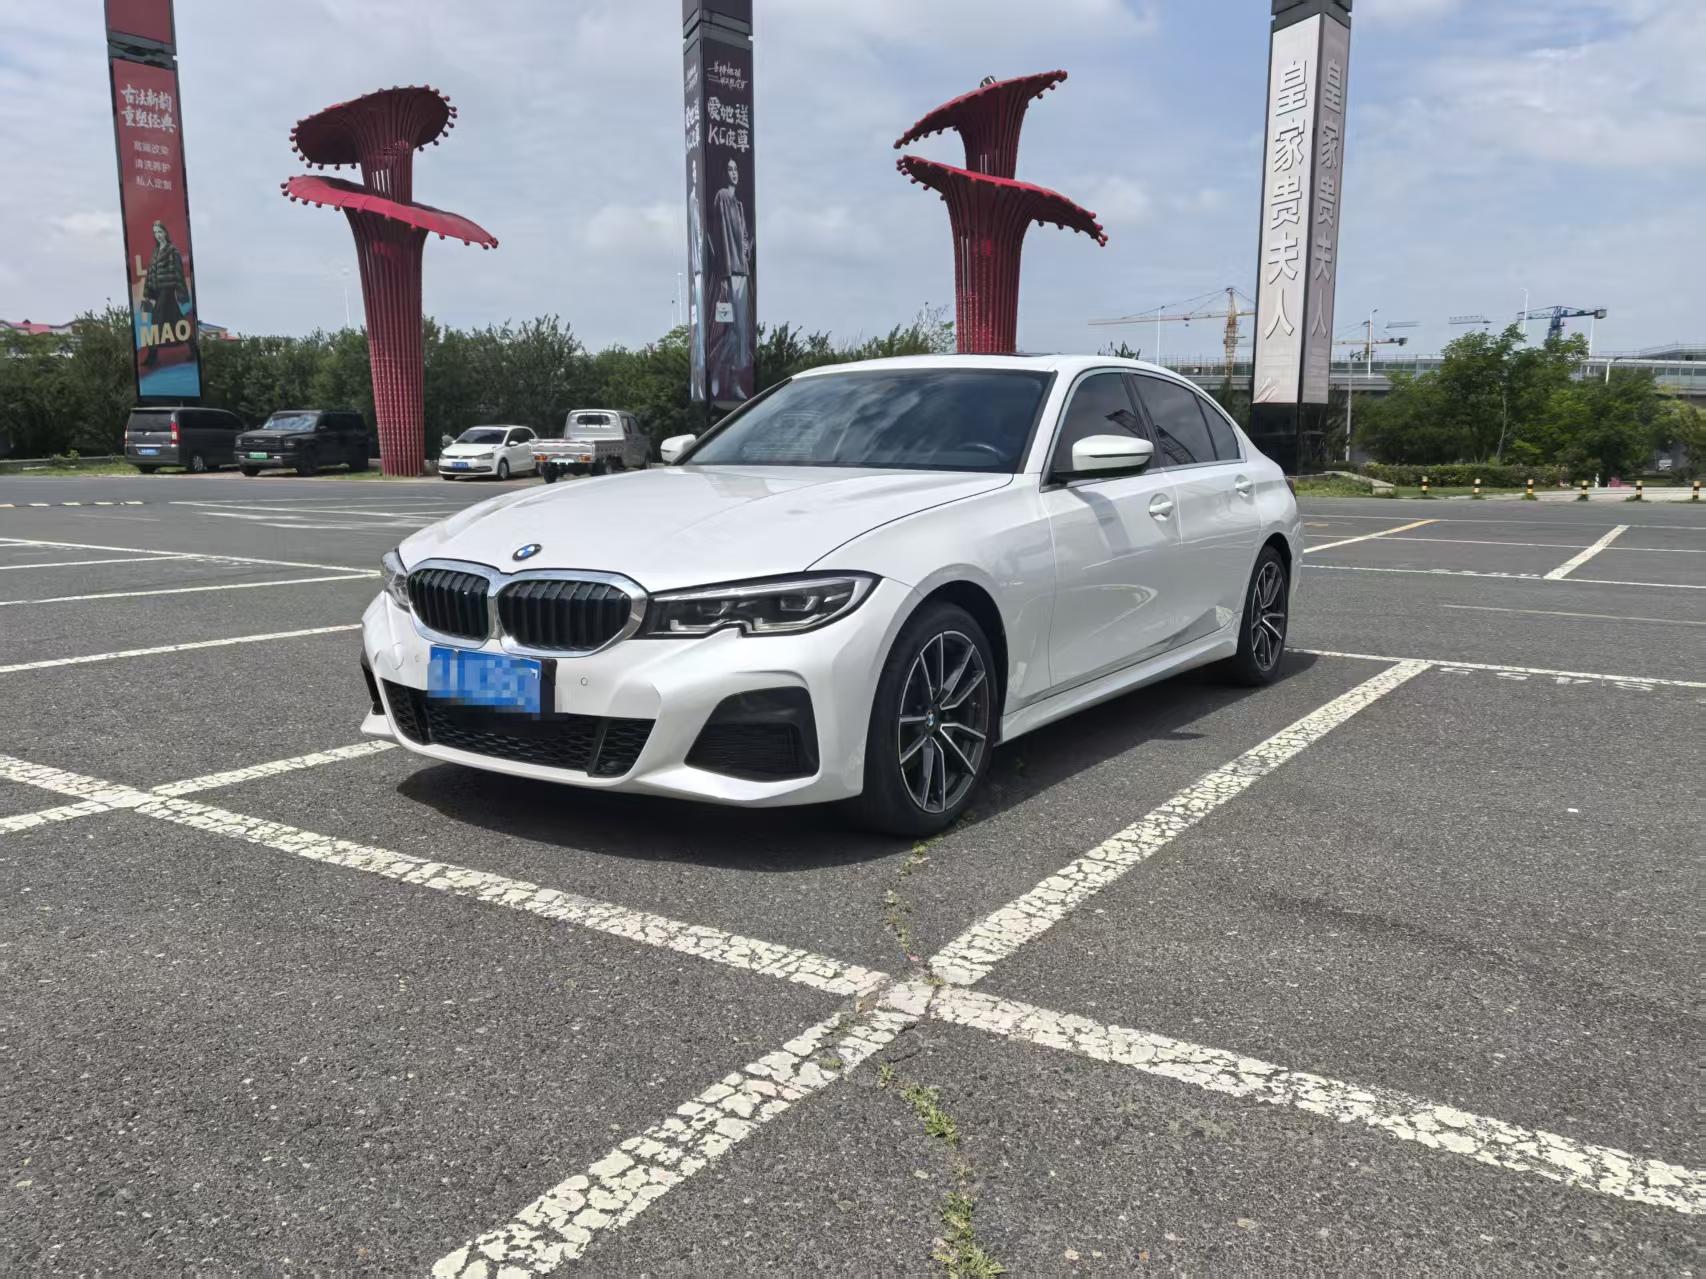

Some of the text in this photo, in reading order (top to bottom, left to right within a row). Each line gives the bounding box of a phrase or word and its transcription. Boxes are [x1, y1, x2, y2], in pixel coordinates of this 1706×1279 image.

[120, 83, 173, 113] 古法新韵
[707, 96, 750, 129] 爱她送
[120, 104, 177, 134] 重塑经典
[1264, 60, 1308, 339] 皇家贵夫人
[1311, 59, 1342, 338] 皇家贵夫人
[140, 319, 191, 347] MAO
